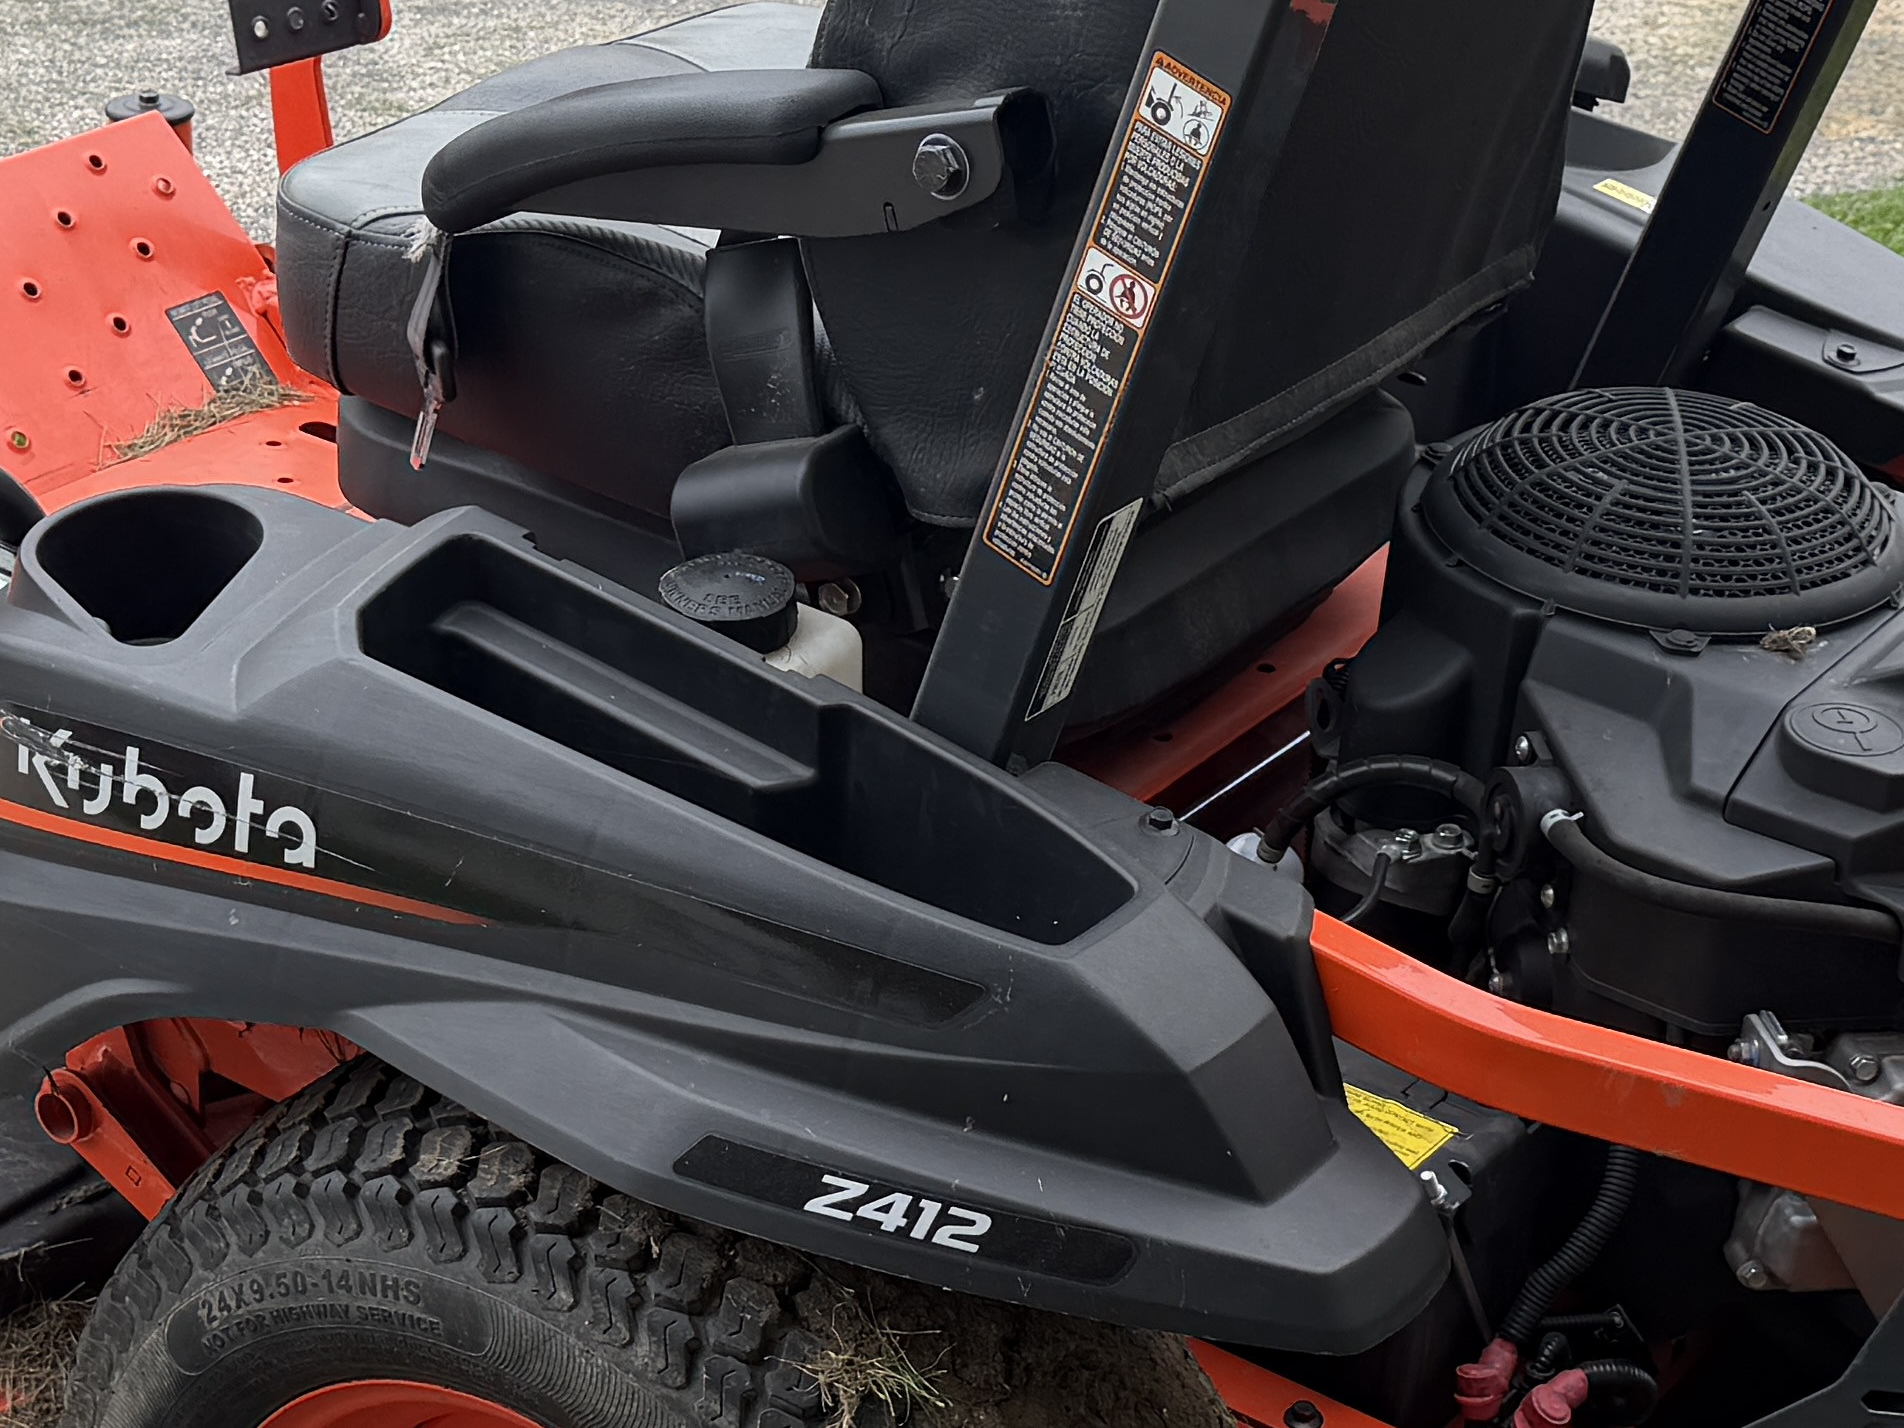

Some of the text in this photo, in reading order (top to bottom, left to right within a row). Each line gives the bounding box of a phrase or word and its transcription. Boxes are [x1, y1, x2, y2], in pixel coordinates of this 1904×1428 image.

[1164, 60, 1228, 106] ADVERTENCIA
[18, 717, 316, 868] Kubota
[804, 1174, 992, 1253] Z412
[356, 1303, 444, 1336] SERVICE
